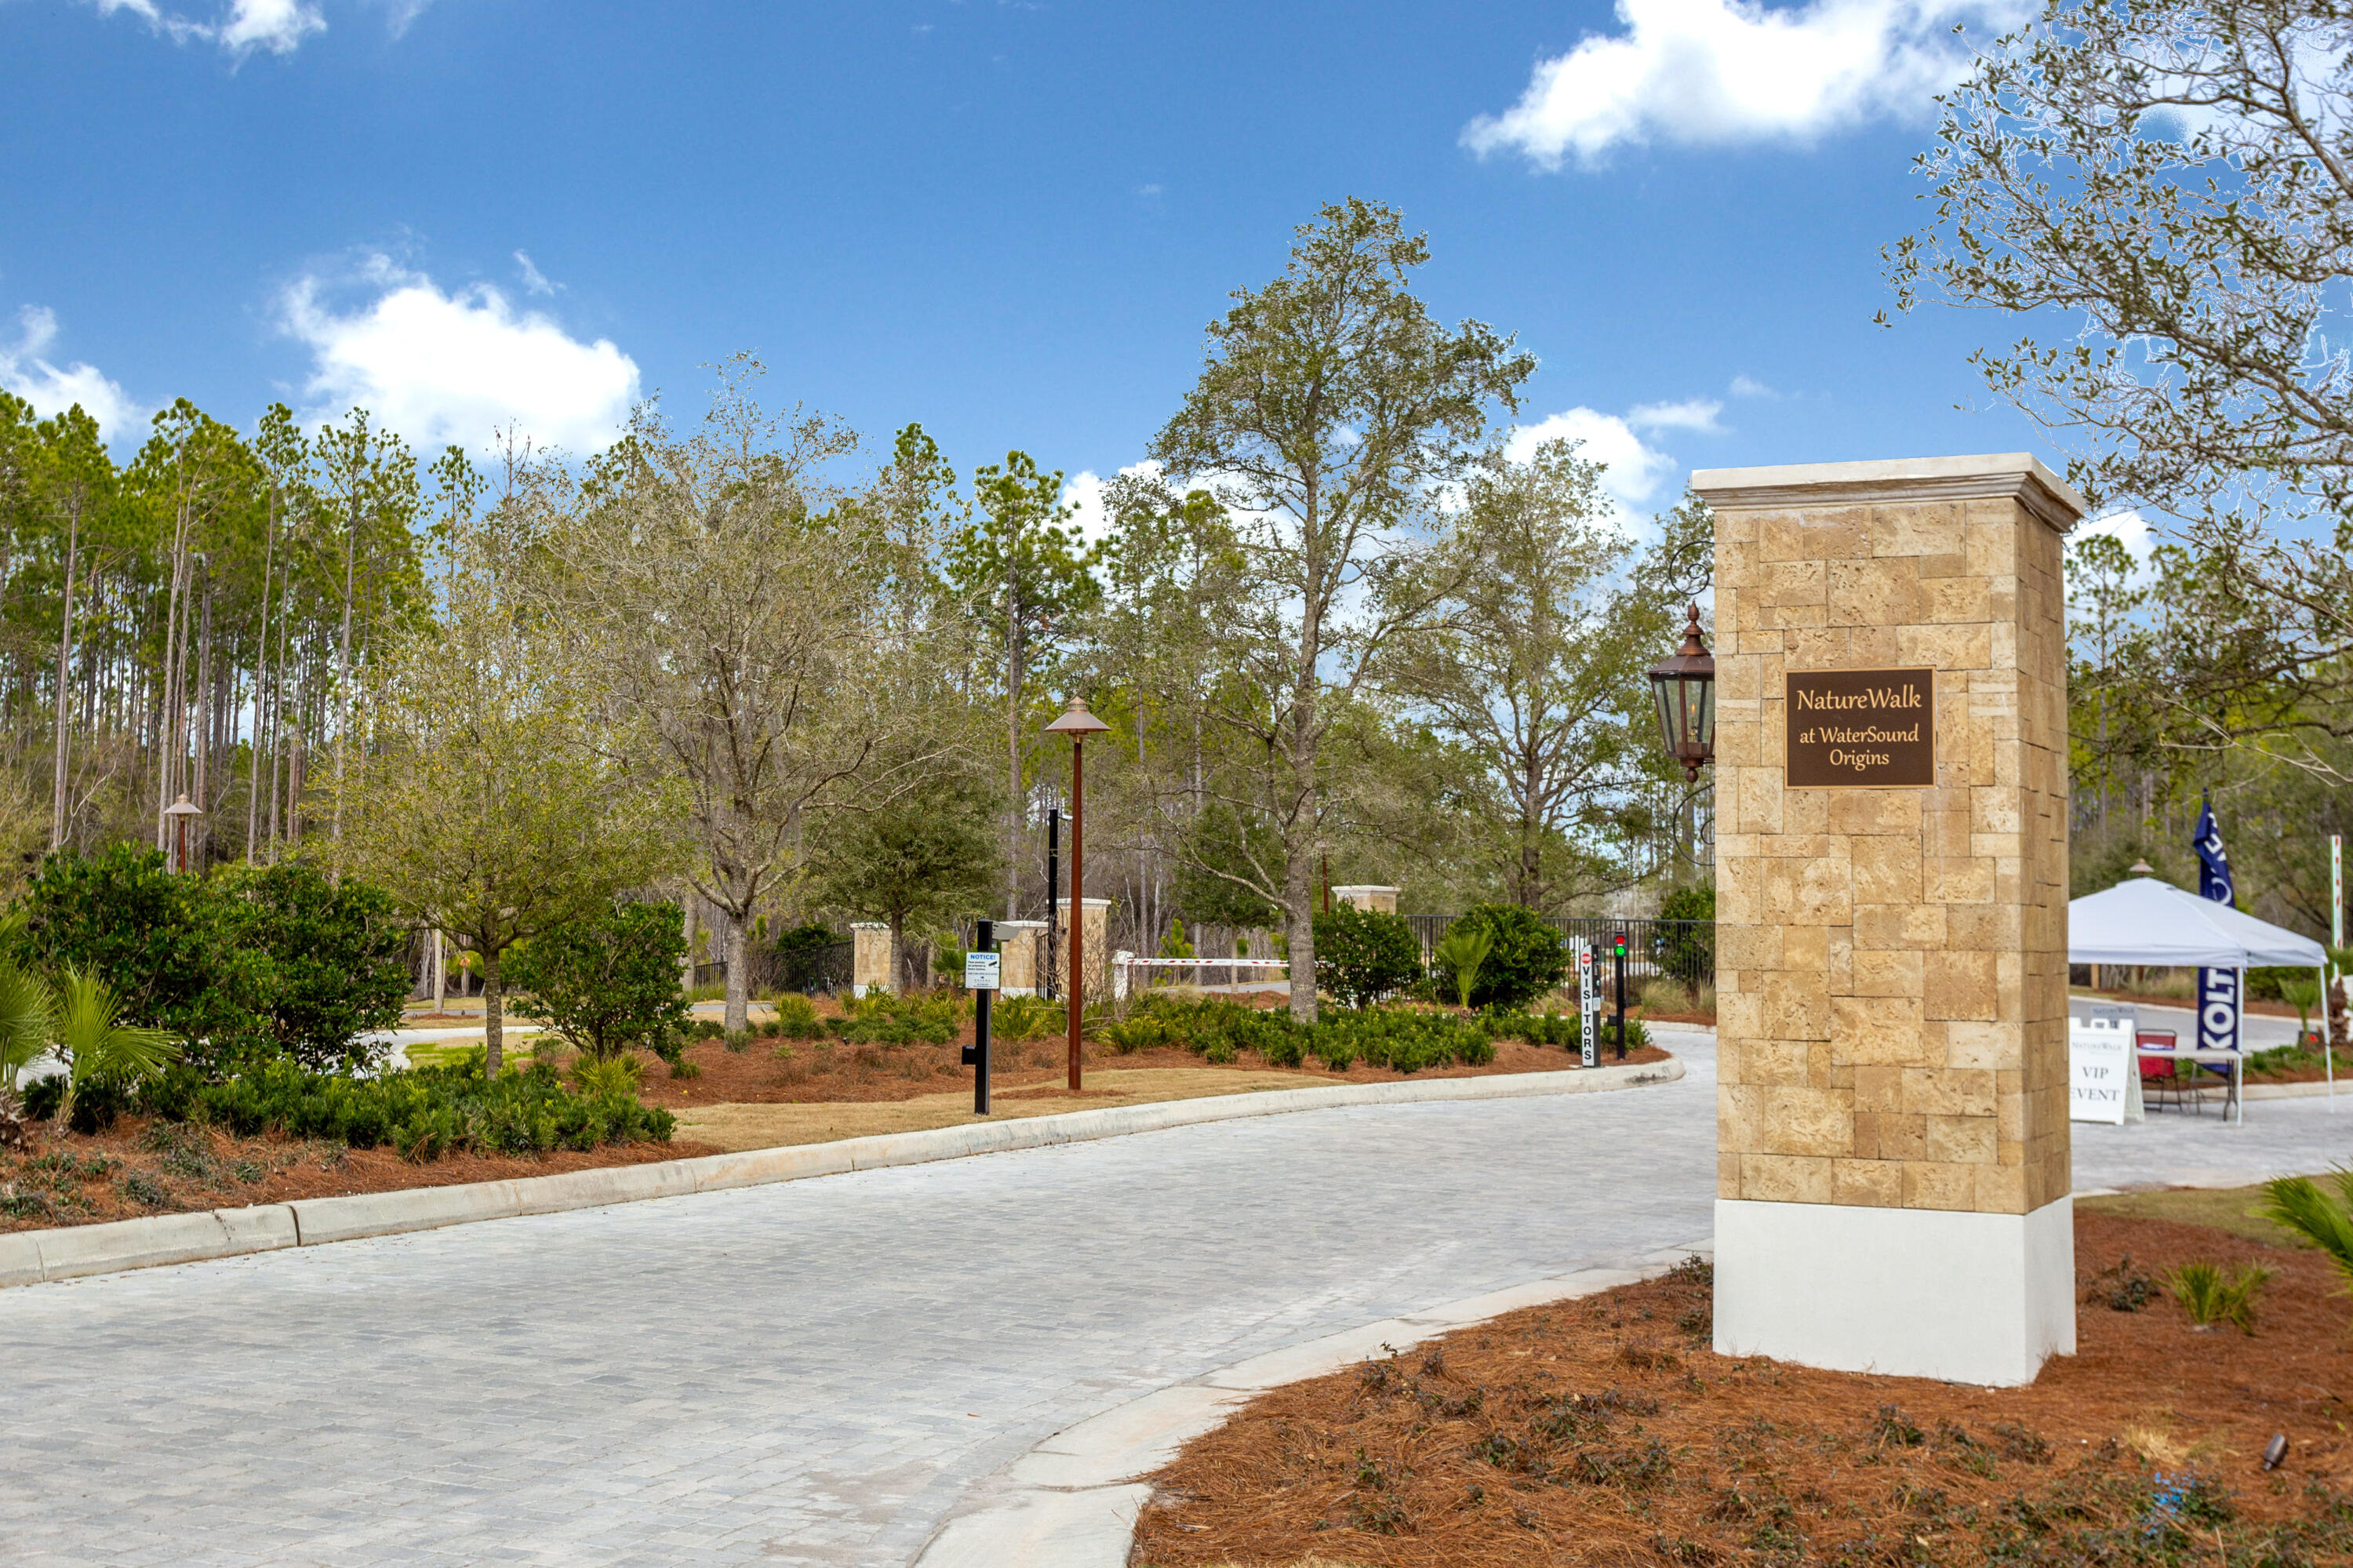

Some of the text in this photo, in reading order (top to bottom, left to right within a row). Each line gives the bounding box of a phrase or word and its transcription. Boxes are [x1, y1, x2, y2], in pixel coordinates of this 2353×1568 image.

[1797, 684, 1922, 710] NatureWalk
[1799, 722, 1919, 744] at WaterSound
[1830, 748, 1889, 771] Origins
[1582, 966, 1591, 1060] VISITORS
[2202, 966, 2235, 1049] KOLT
[2082, 1066, 2109, 1079] VIP
